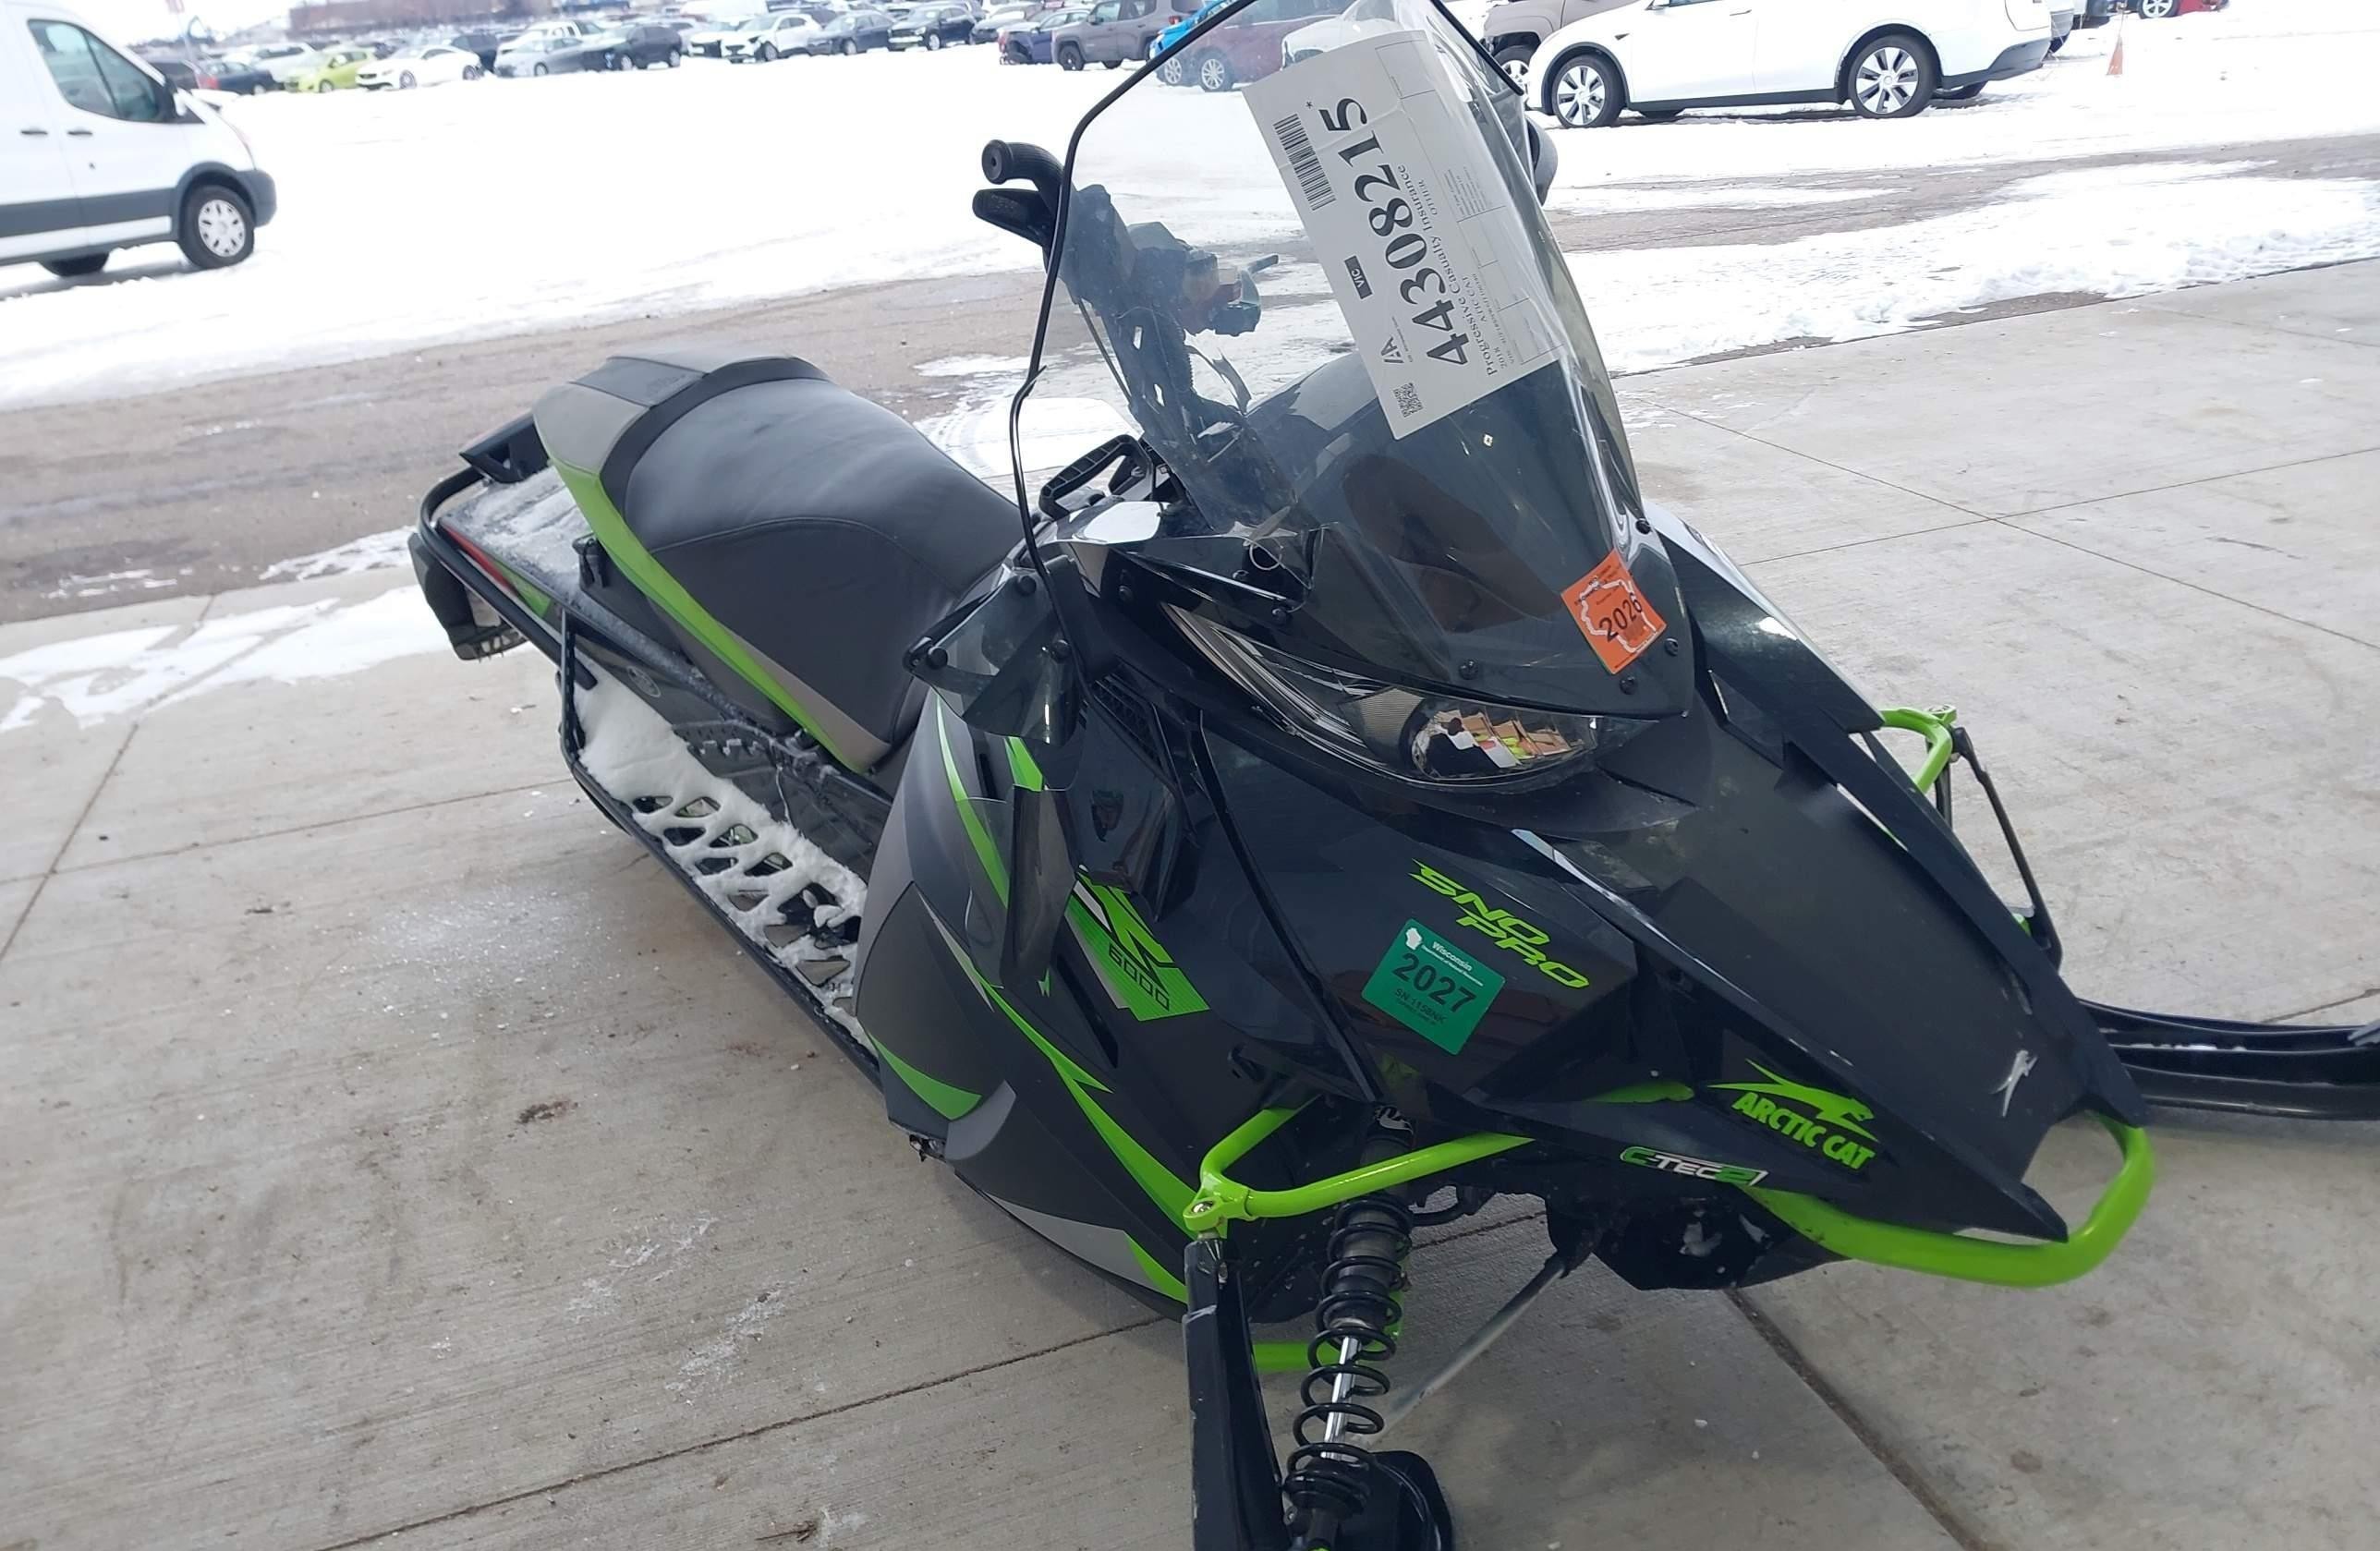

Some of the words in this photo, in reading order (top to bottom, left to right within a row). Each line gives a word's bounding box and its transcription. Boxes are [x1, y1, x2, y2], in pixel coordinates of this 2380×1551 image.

[1318, 96, 1470, 366] 44308215
[1397, 164, 1432, 231] Insurance
[1350, 267, 1366, 288] VIC
[1428, 235, 1461, 293] Casualty
[1457, 297, 1498, 377] Progressive
[1599, 593, 1643, 642] 2026
[1408, 858, 1550, 945] SNO
[1109, 943, 1171, 1012] 6000
[1431, 940, 1473, 972] Wisconsin
[1455, 905, 1590, 988] PRO
[1392, 952, 1477, 1012] 2027
[1731, 1092, 1827, 1147] ARCTIC
[1822, 1128, 1876, 1170] CAT
